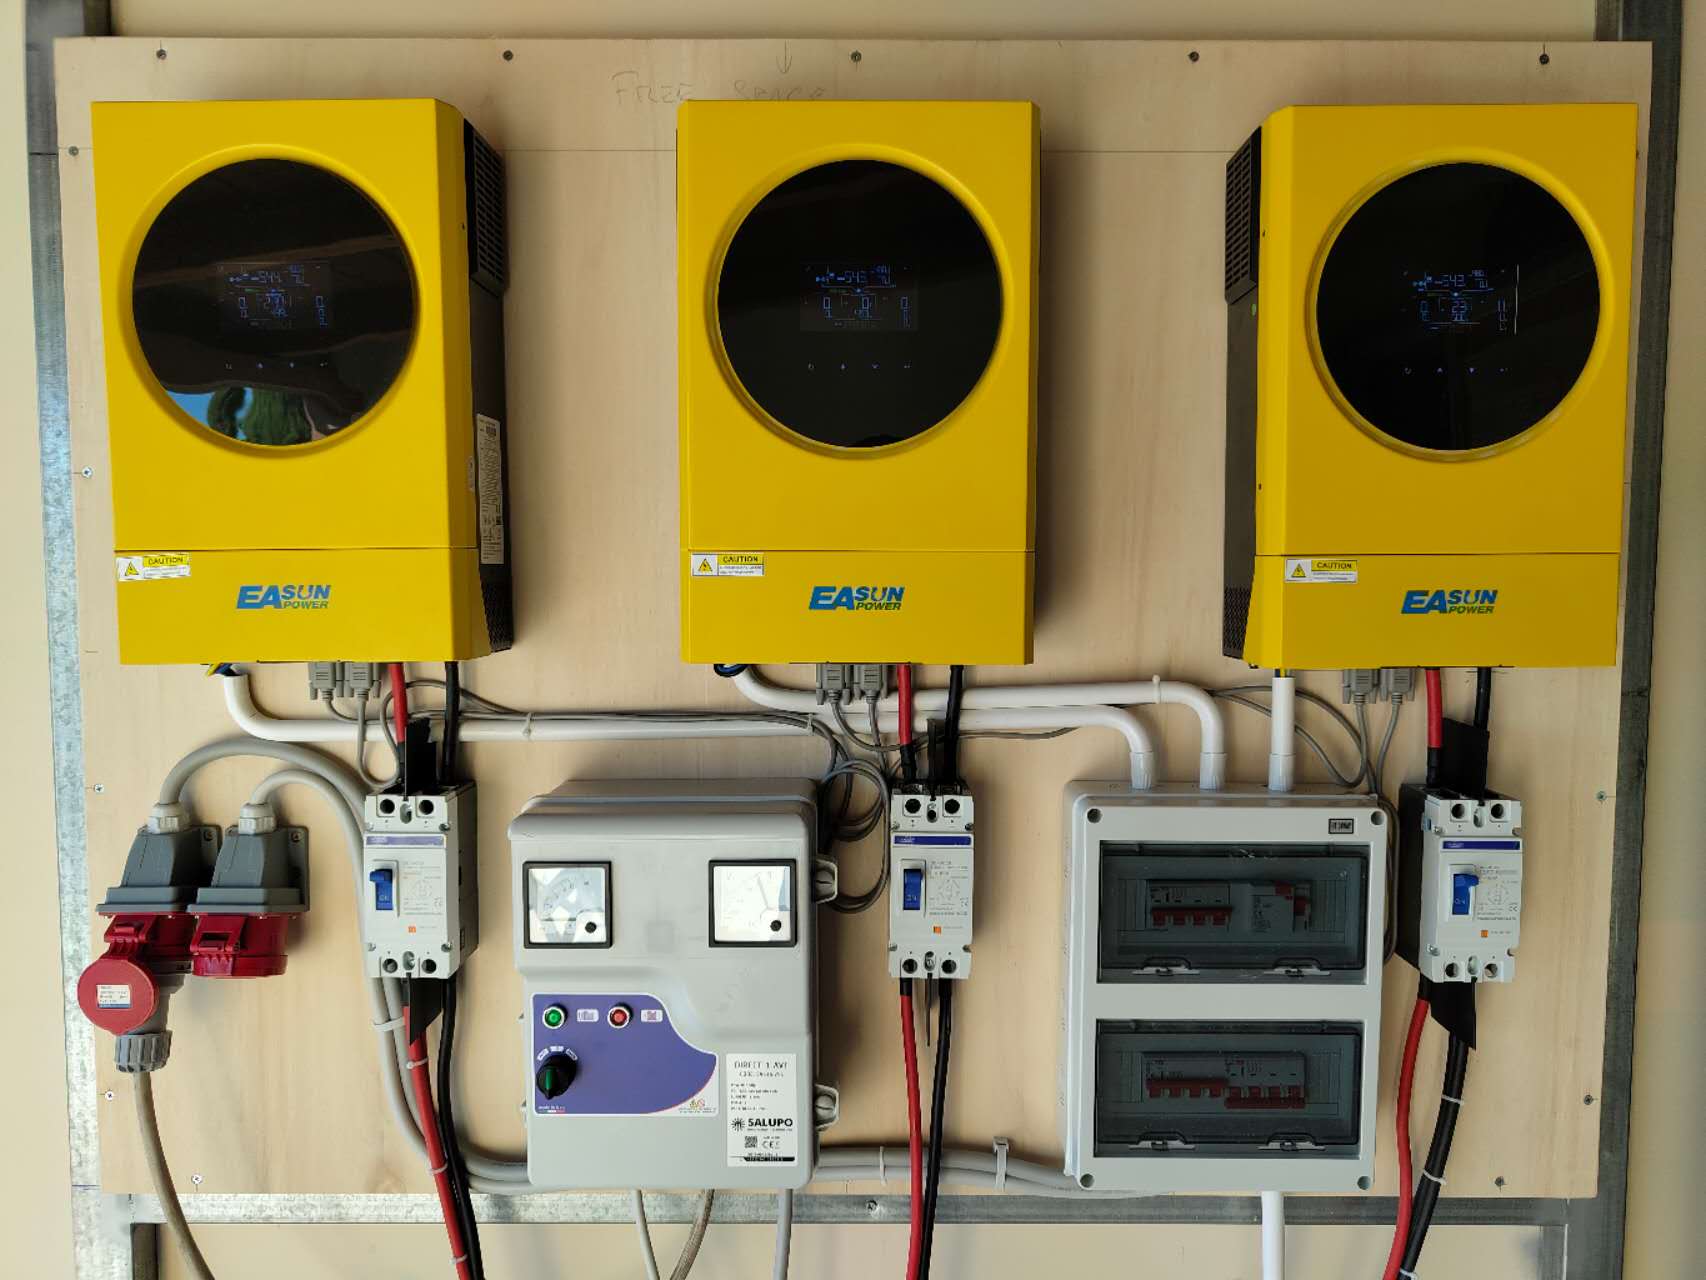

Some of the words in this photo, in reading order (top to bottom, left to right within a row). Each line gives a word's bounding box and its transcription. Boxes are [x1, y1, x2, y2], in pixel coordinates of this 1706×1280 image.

[148, 556, 184, 566] CAUTION
[723, 555, 758, 563] CAUTION
[236, 584, 331, 610] EASUN
[808, 585, 905, 611] EASUN
[1401, 589, 1498, 615] EASUN
[283, 600, 329, 610] POWER
[855, 602, 901, 611] POWER
[1448, 605, 1494, 614] POWER
[747, 1117, 793, 1128] SALUPO
